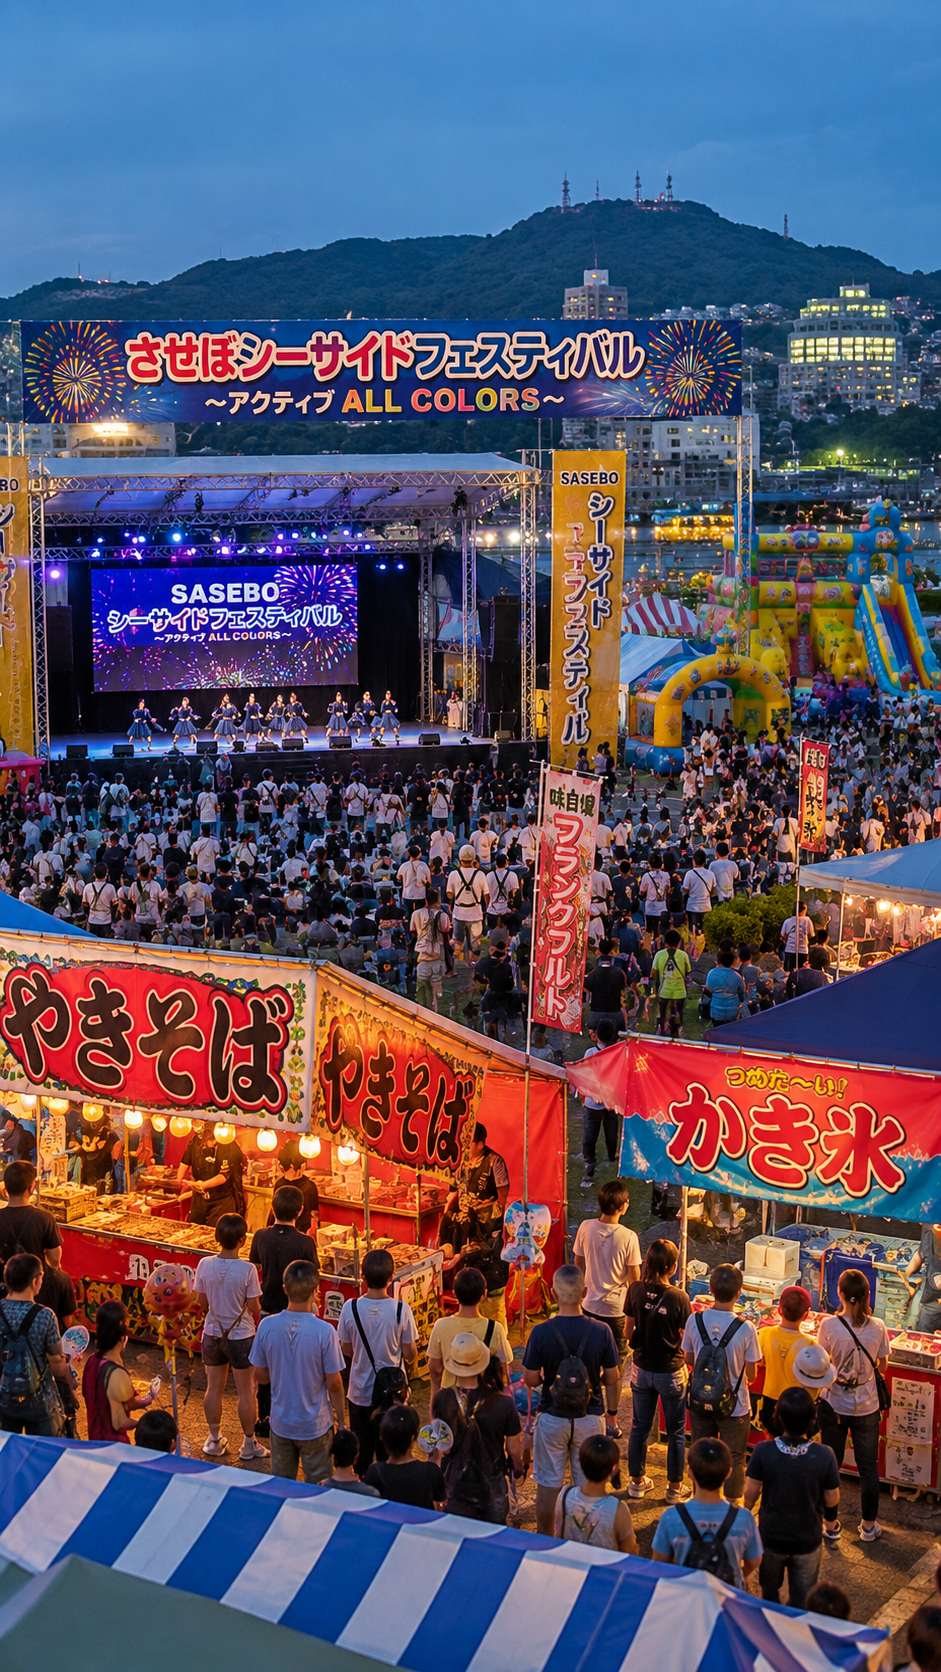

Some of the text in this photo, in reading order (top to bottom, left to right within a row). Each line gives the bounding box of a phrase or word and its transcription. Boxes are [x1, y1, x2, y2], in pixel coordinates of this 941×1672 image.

[125, 330, 645, 383] させぼシーサイドフェスティバル
[341, 389, 402, 412] ALL
[560, 470, 620, 486] SASEBO
[587, 490, 615, 630] シーサイド
[107, 605, 343, 633] シーサイドフェスティバル
[171, 582, 280, 604] SASEBO
[208, 632, 231, 641] ALL
[543, 813, 584, 1020] フランクフルト
[3, 965, 290, 1107] やきそば
[322, 1022, 476, 1165] やきそば
[666, 1082, 906, 1198] かき氷
